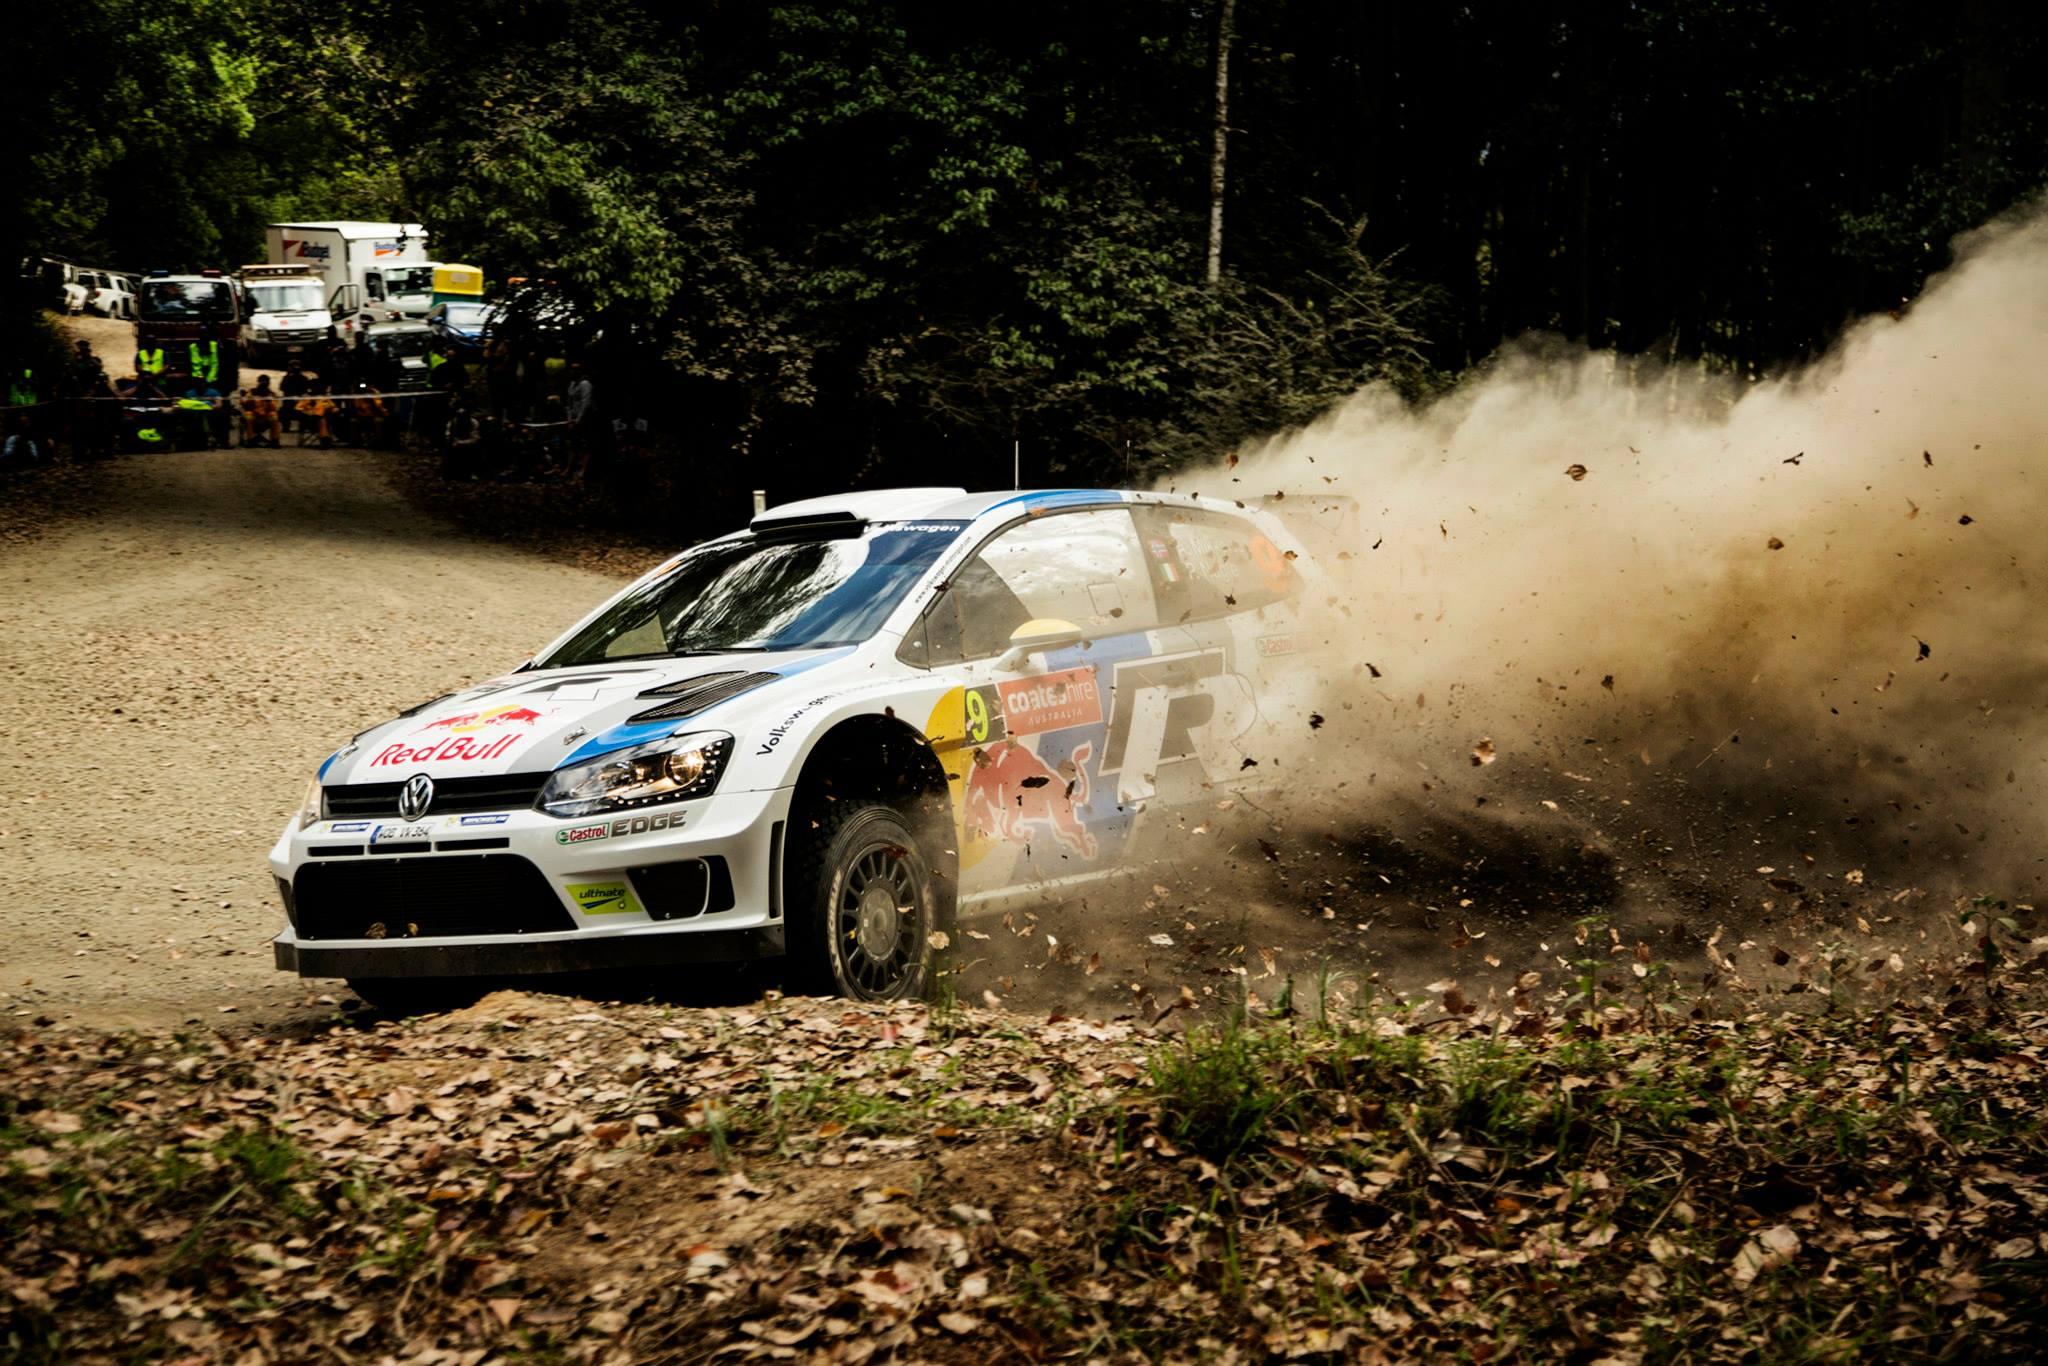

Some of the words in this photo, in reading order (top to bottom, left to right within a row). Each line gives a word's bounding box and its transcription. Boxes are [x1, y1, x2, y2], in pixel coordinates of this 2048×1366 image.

[864, 523, 960, 533] Vkswagen
[966, 690, 989, 742] 9
[1029, 708, 1083, 725] AUSTRALIA
[370, 737, 450, 767] Red
[436, 734, 524, 762] Bull
[569, 825, 606, 842] Castrol
[611, 810, 688, 838] EDGE
[579, 887, 626, 899] ultimate
